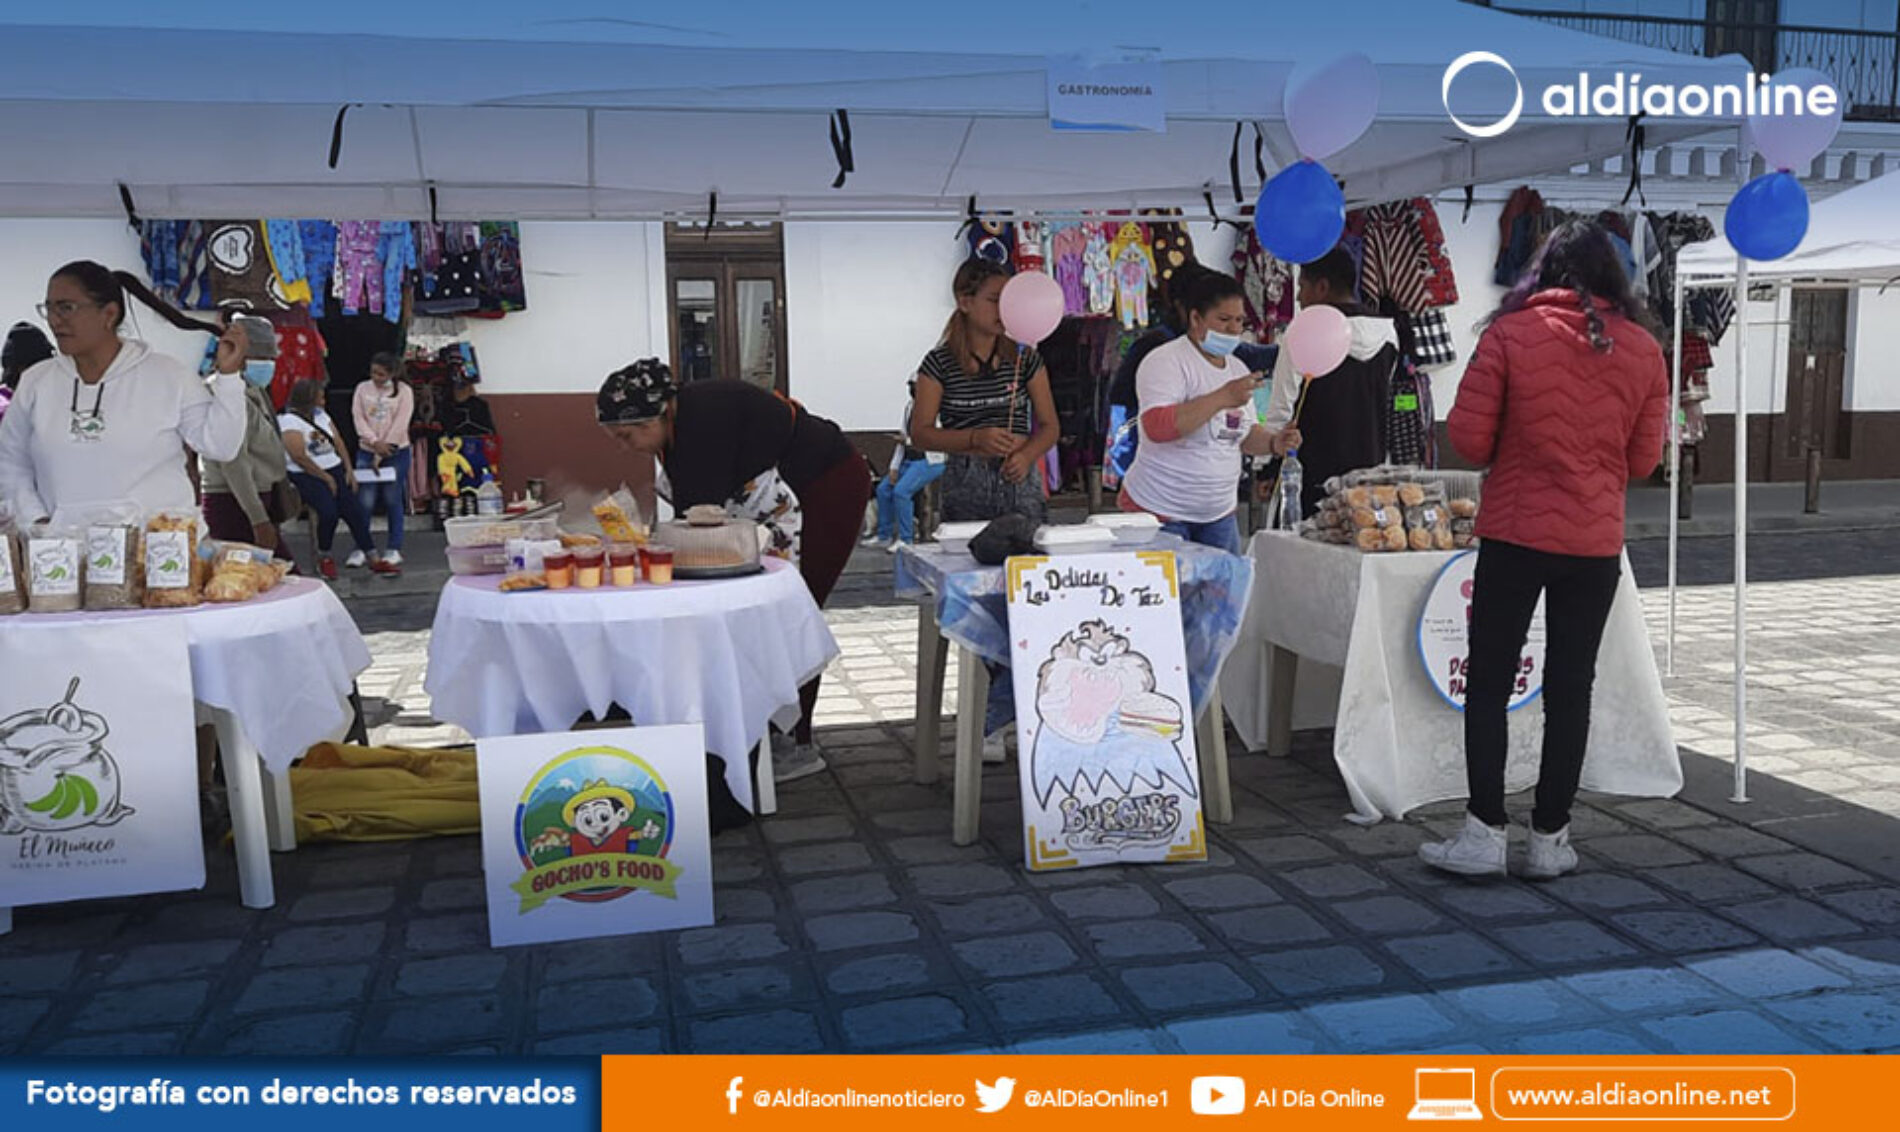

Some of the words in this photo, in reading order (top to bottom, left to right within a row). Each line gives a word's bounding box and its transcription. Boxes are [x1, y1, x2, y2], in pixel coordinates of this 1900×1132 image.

[1100, 585, 1125, 607] De
[1059, 792, 1181, 840] BURGERS
[20, 834, 41, 859] El
[531, 860, 611, 894] GOCHO'S
[616, 860, 666, 882] FOOD
